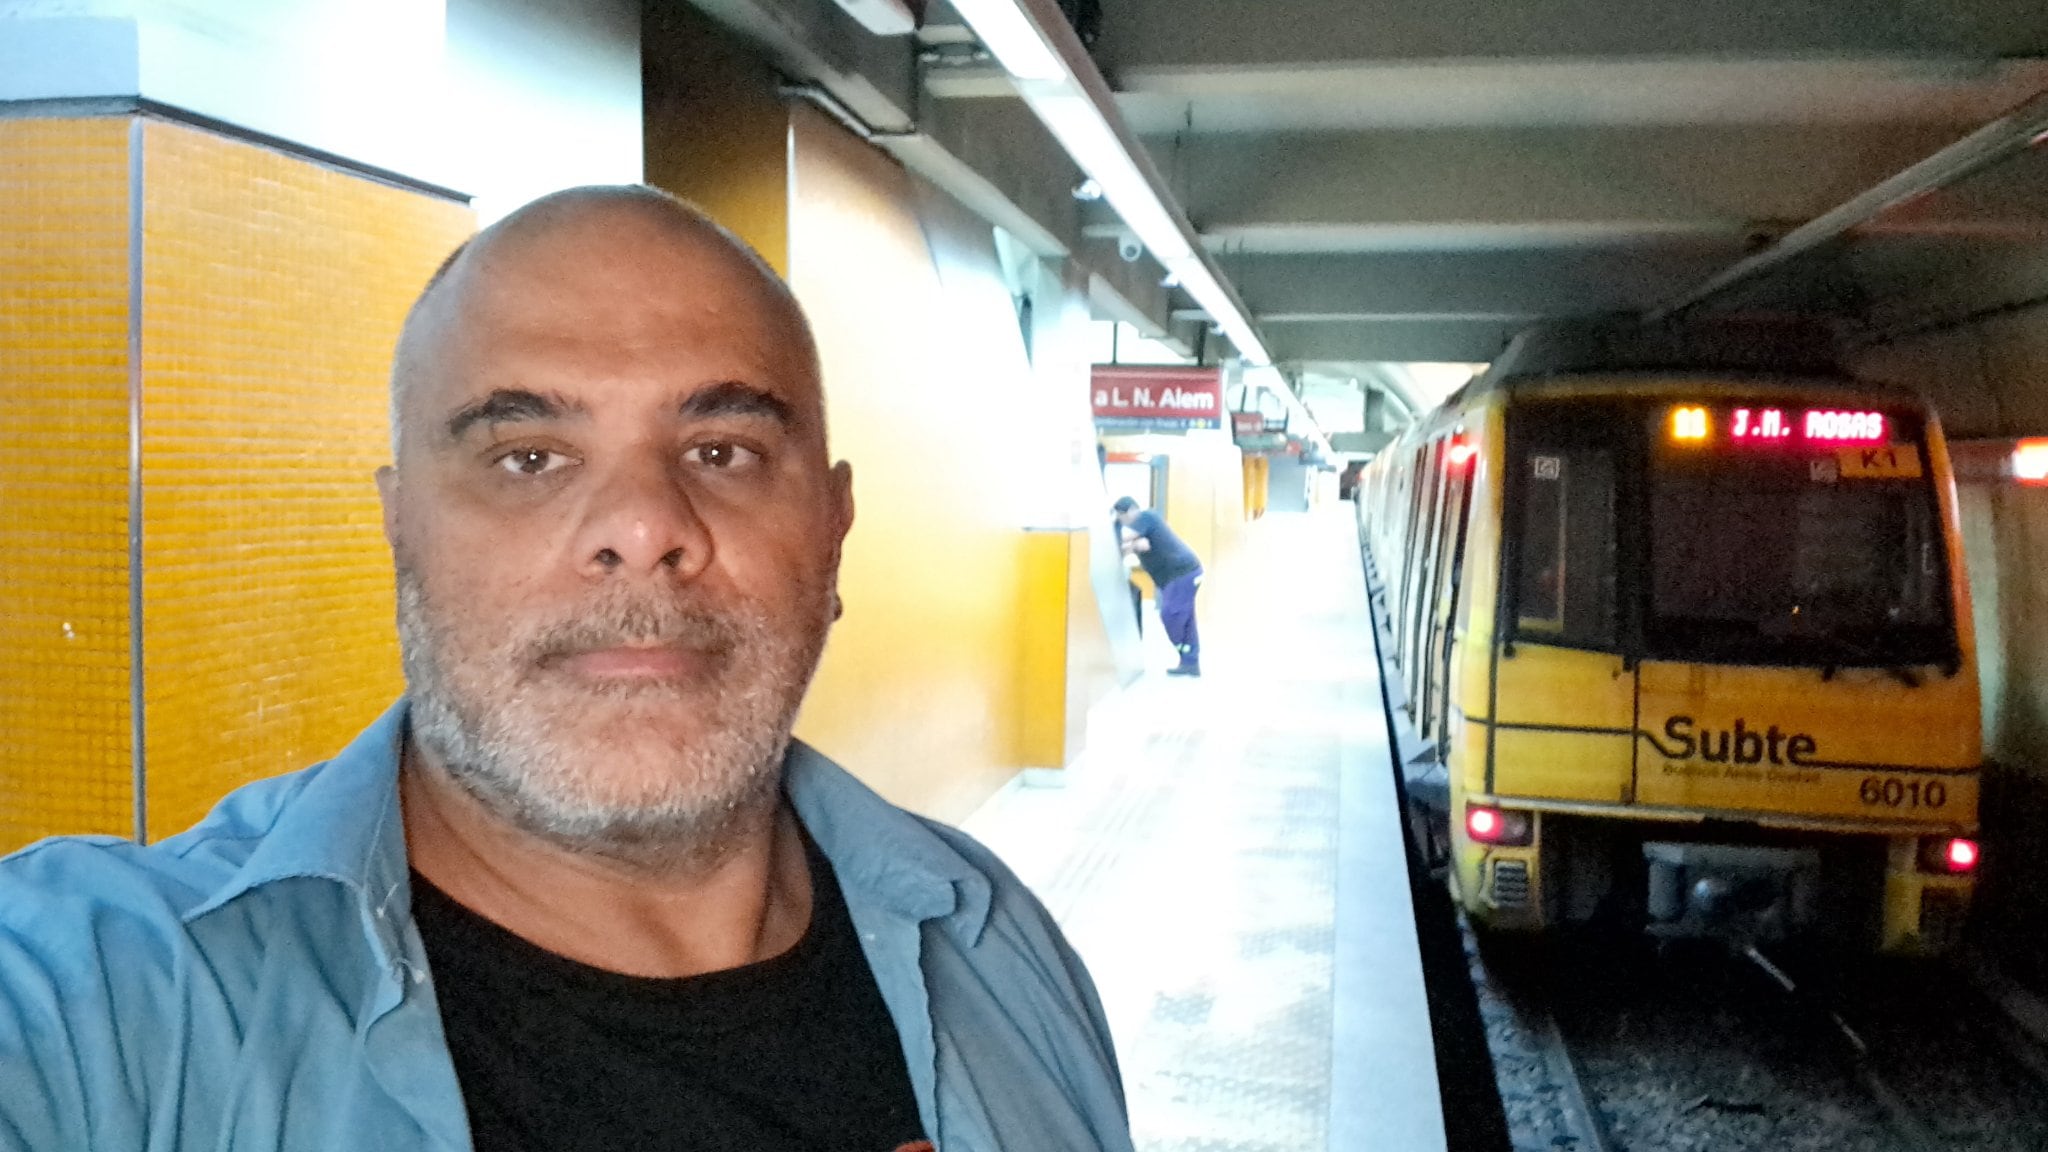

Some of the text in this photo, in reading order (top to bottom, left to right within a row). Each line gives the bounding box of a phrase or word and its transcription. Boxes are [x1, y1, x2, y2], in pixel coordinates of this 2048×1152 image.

[1095, 386, 1214, 409] a L. N. Alem
[1664, 715, 1816, 765] Subte
[1859, 776, 1947, 808] 6010
